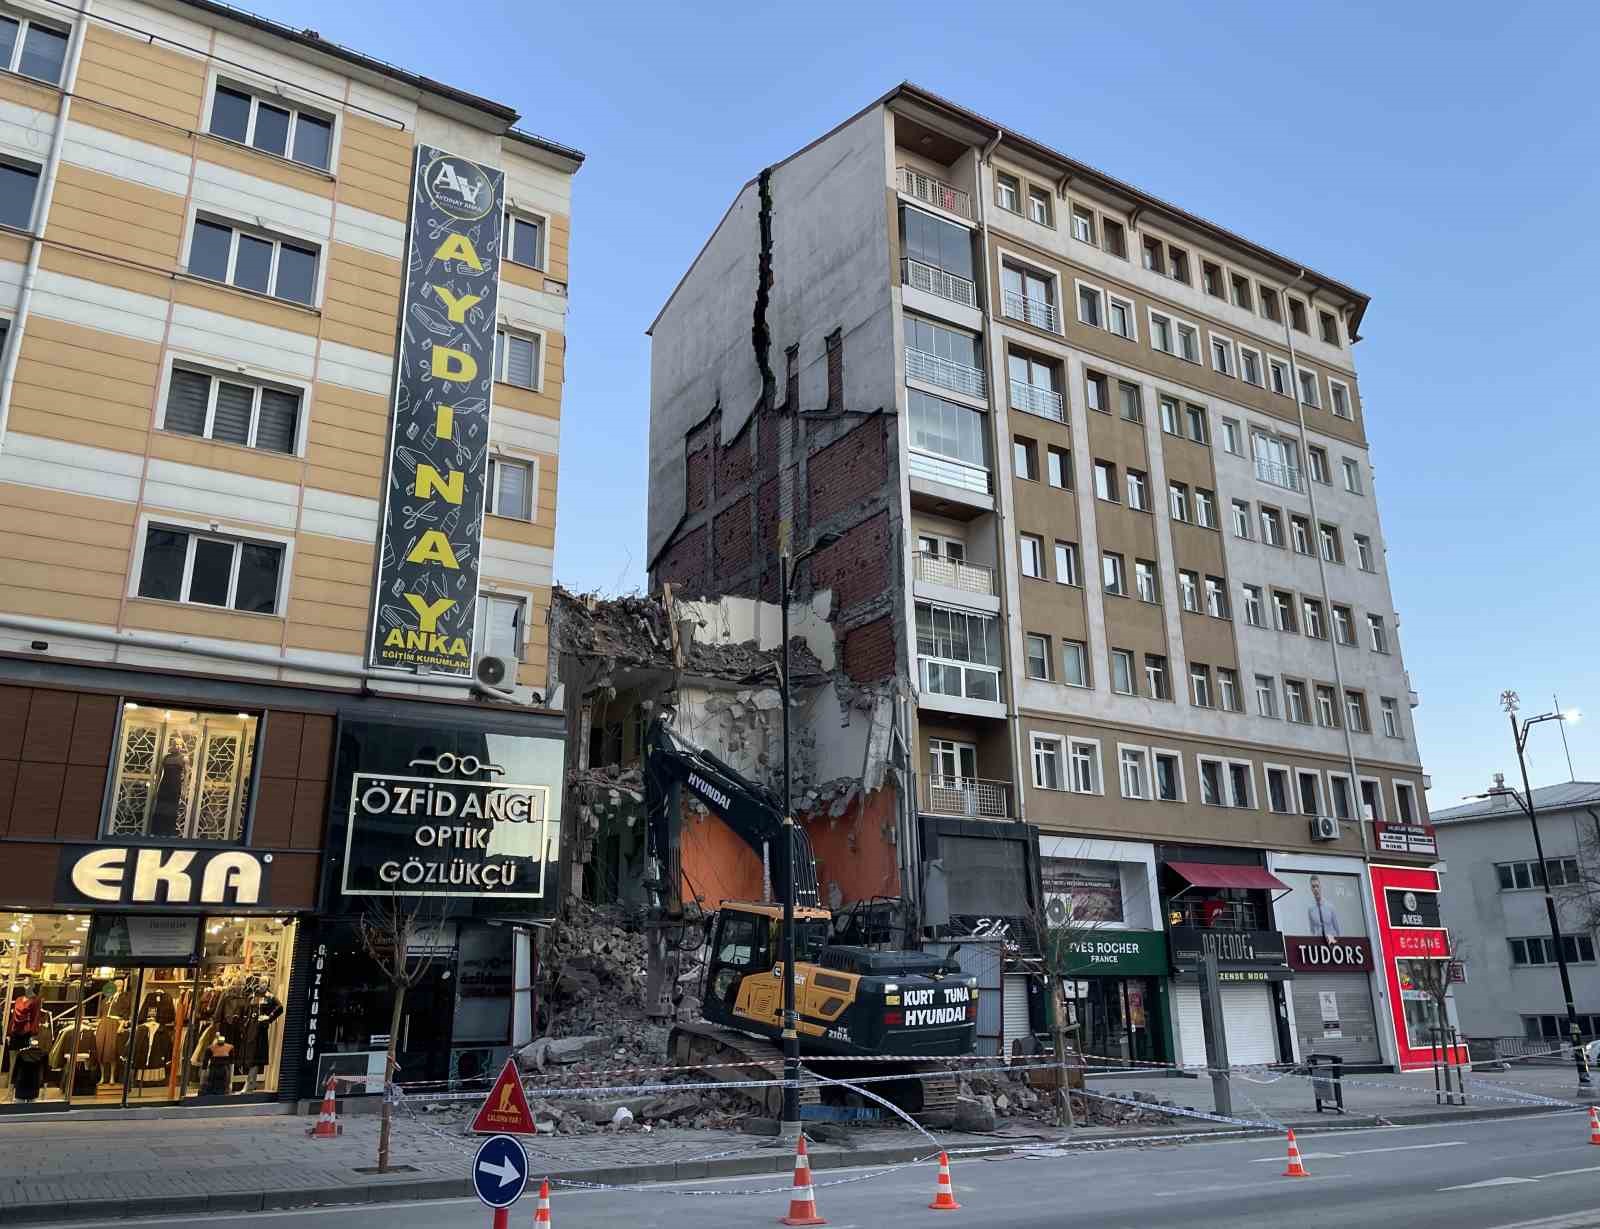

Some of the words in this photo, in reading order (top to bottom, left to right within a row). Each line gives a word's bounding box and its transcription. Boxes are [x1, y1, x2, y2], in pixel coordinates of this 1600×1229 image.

[402, 233, 484, 632] AYDINAY
[384, 628, 468, 657] ANKA
[688, 772, 731, 810] HYUNDAI
[415, 822, 487, 849] OPTİK
[72, 848, 262, 904] EKA
[379, 856, 517, 890] GÖZLÜKÇÜ
[1402, 914, 1423, 925] AKER
[1097, 942, 1140, 954] ROCHER
[1298, 944, 1364, 965] TUDORS
[1400, 937, 1441, 950] ECZANE
[1090, 955, 1118, 963] FRANCE
[903, 989, 935, 1007] KURT
[943, 986, 969, 1004] TUNA
[904, 1005, 966, 1027] HYUNDAI
